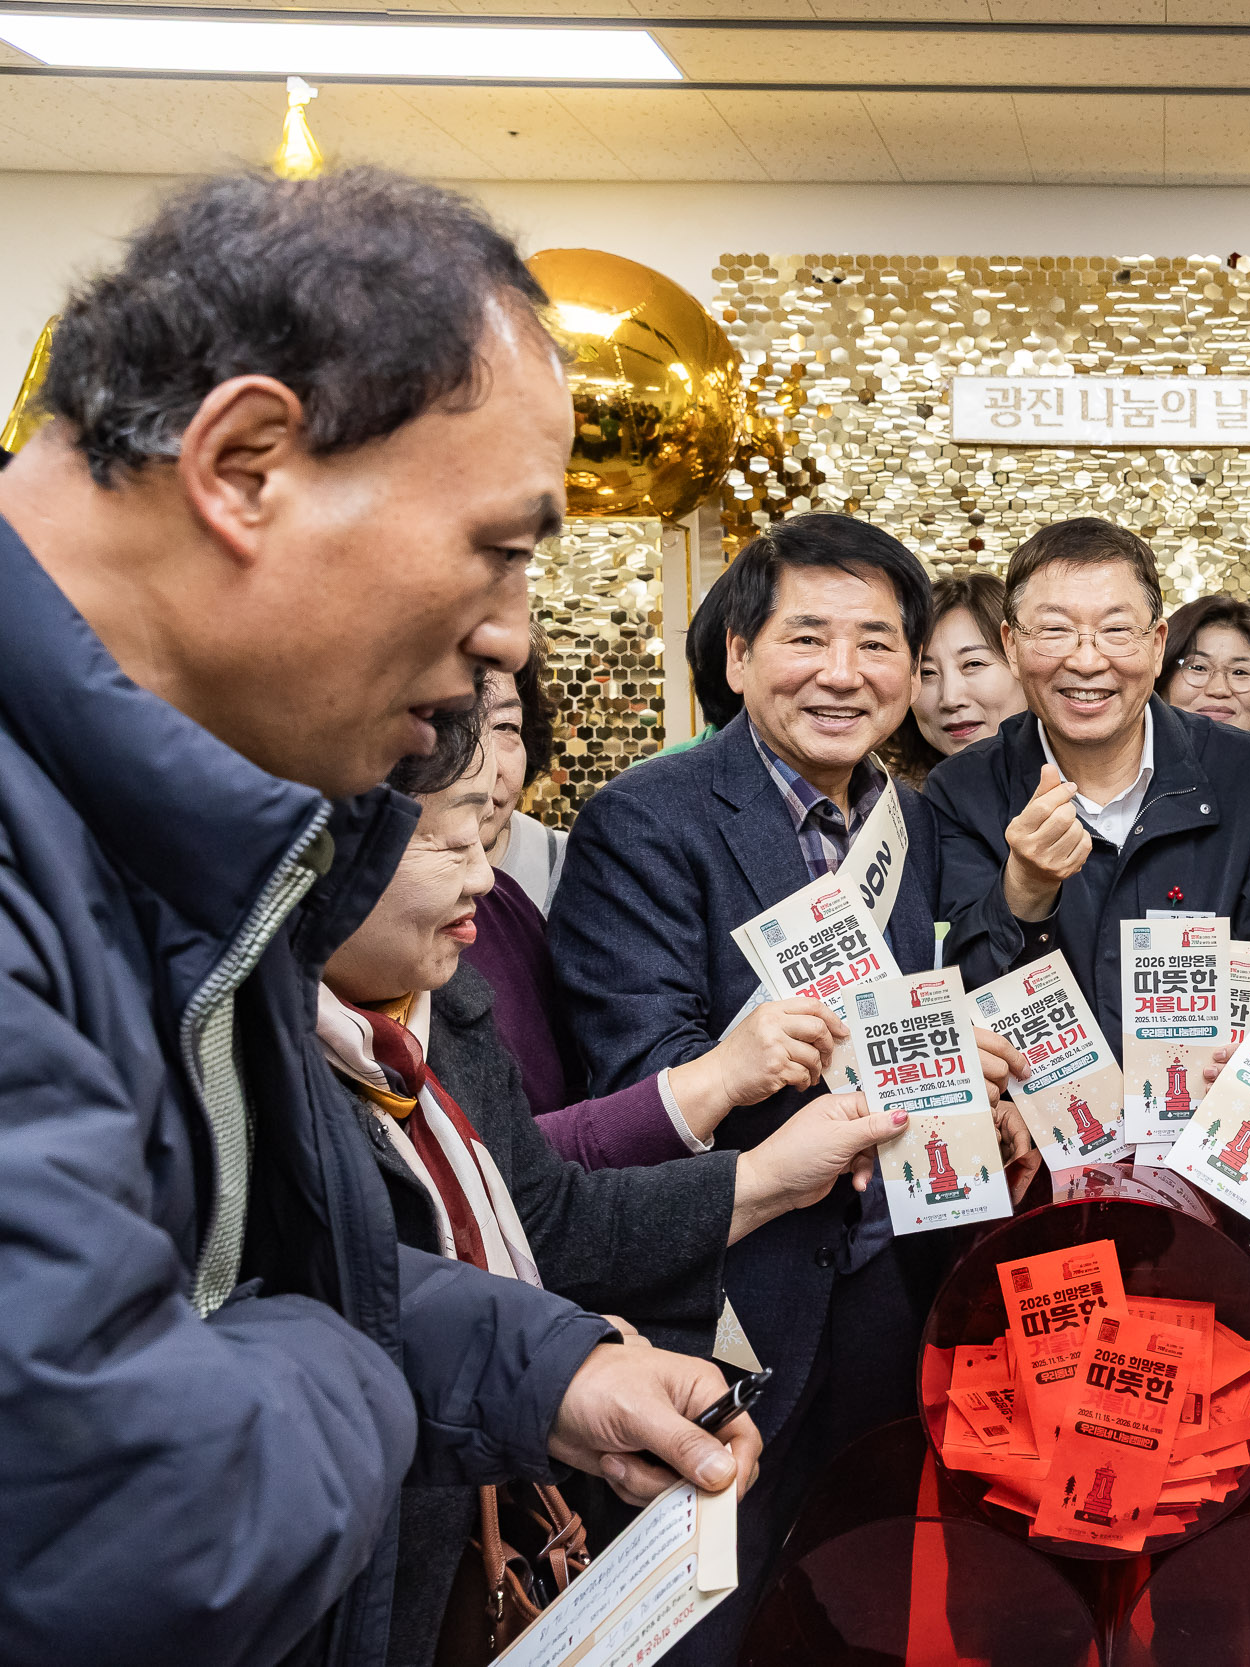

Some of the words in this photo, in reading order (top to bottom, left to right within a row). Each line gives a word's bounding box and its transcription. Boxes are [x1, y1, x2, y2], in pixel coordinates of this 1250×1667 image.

[984, 386, 1064, 429] 광진
[1079, 388, 1197, 429] 나눔의
[776, 941, 809, 964] 2026
[809, 914, 860, 949] 희망온돌
[782, 929, 871, 989] 따뜻한
[1135, 957, 1165, 968] 2026
[1168, 955, 1217, 968] 희망온돌
[1134, 969, 1218, 994] 따뜻한
[990, 1013, 1021, 1034] 2026
[1021, 988, 1069, 1020] 희망온돌
[1135, 995, 1216, 1014] 겨울나기
[864, 1022, 899, 1039] 2026
[900, 1010, 955, 1033] 희망온돌
[867, 1026, 961, 1067] 따뜻한
[1021, 1024, 1088, 1068] 울나기
[874, 1055, 966, 1088] 겨울나기
[1019, 1294, 1051, 1312] 2026
[1053, 1281, 1104, 1304] 희망온돌
[1094, 1348, 1126, 1366] 2026
[1127, 1356, 1179, 1380] 희망온돌
[1086, 1362, 1175, 1405] 따뜻한
[1081, 1389, 1167, 1425] 겨울나기
